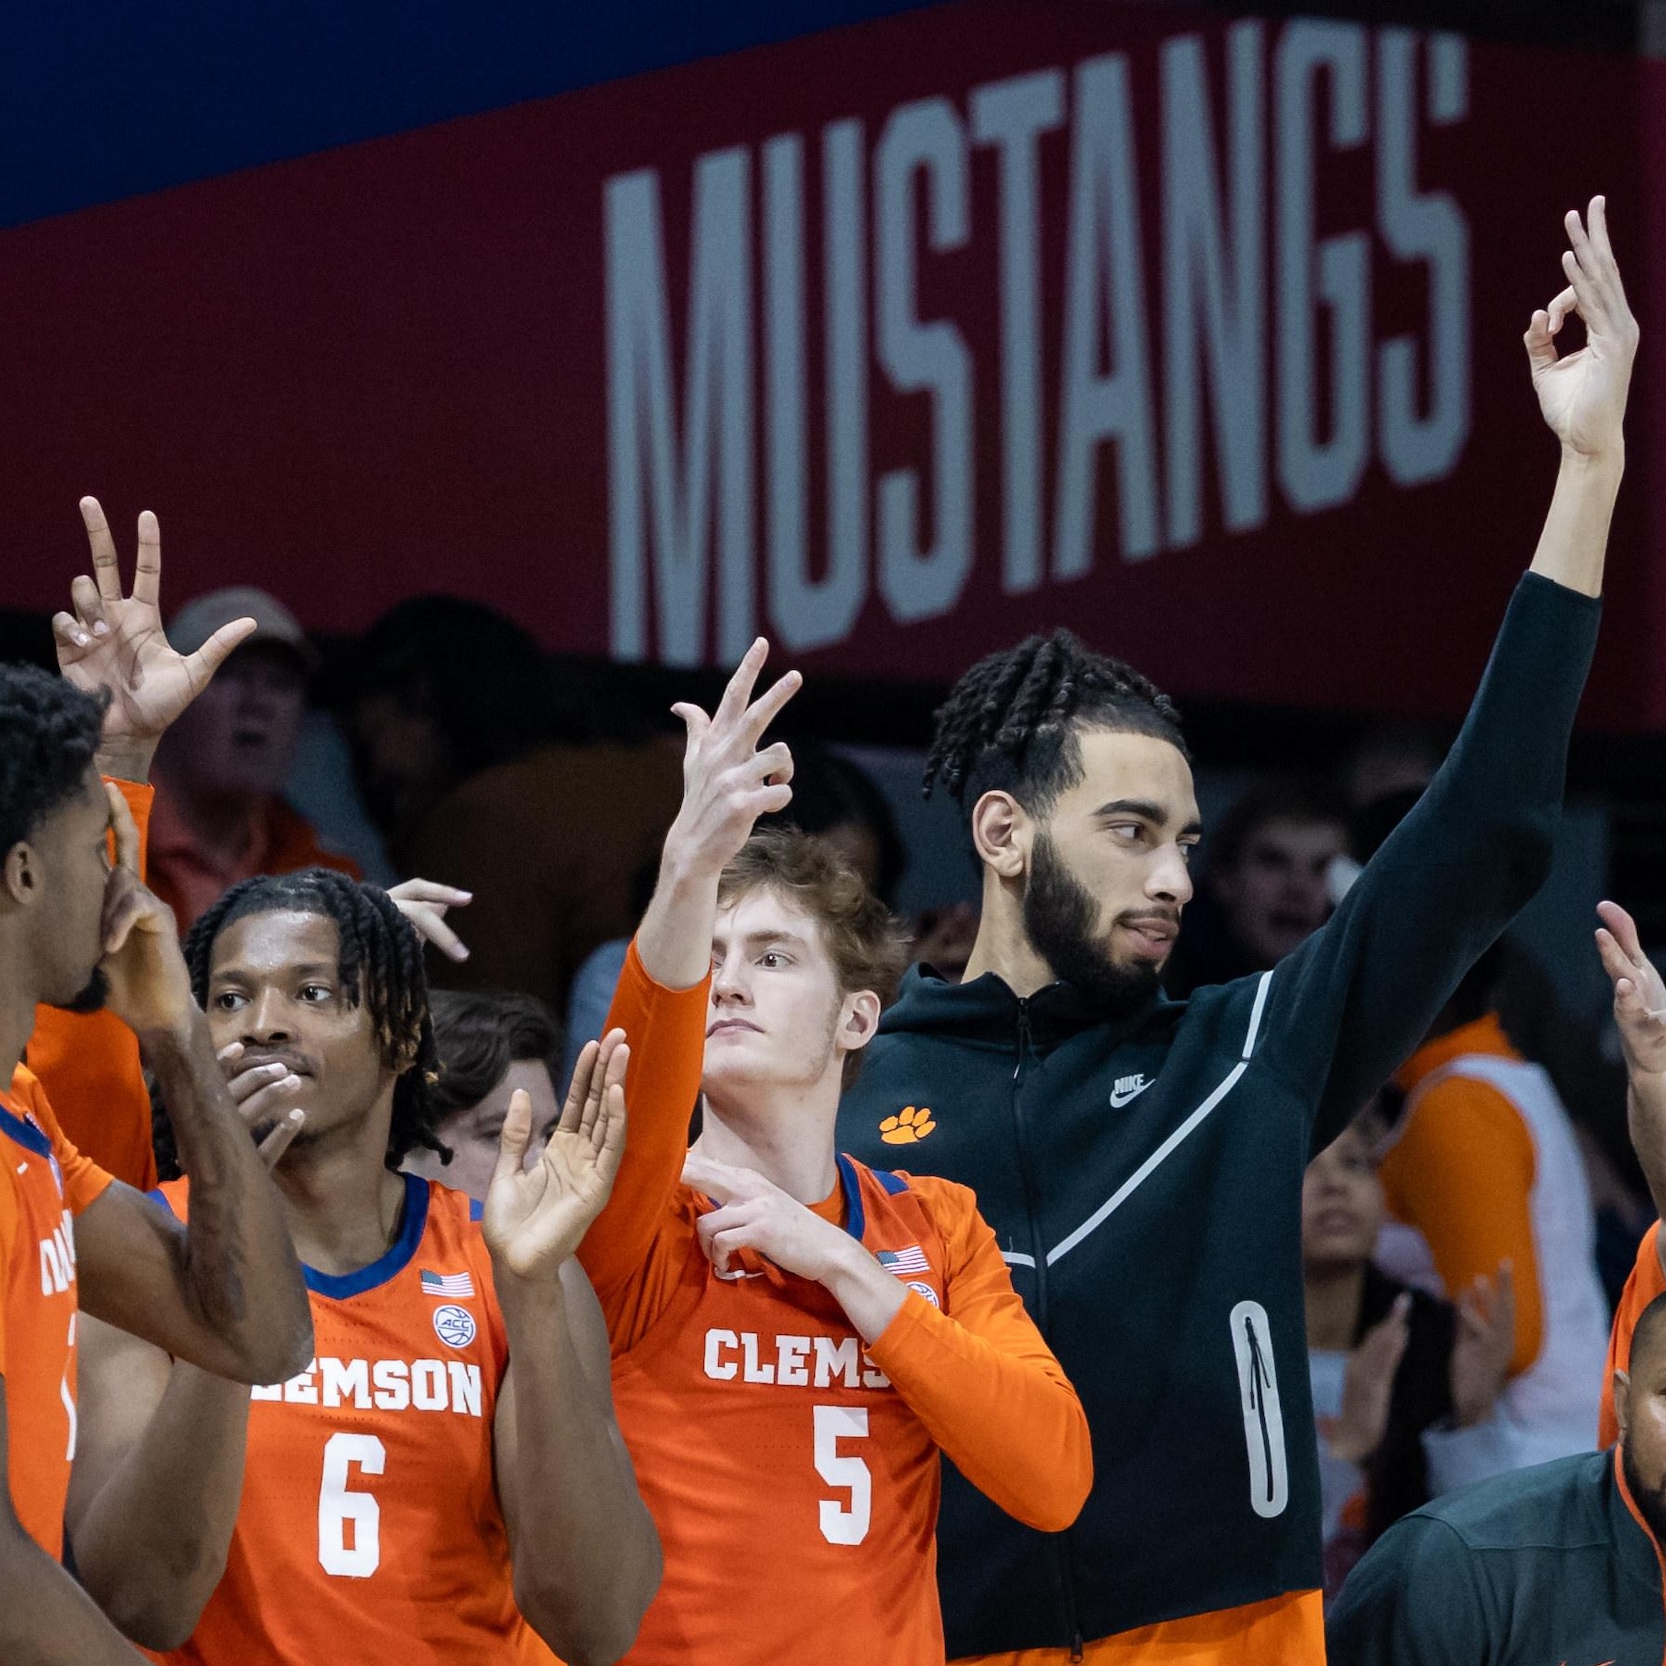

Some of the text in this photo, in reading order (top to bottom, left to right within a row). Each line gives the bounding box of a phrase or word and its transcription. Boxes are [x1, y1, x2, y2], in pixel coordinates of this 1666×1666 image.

[603, 16, 1469, 669] MUSTANGS
[250, 1357, 483, 1418] EMSON
[441, 1319, 470, 1329] ACC
[317, 1431, 386, 1578] 6
[812, 1404, 872, 1546] 5
